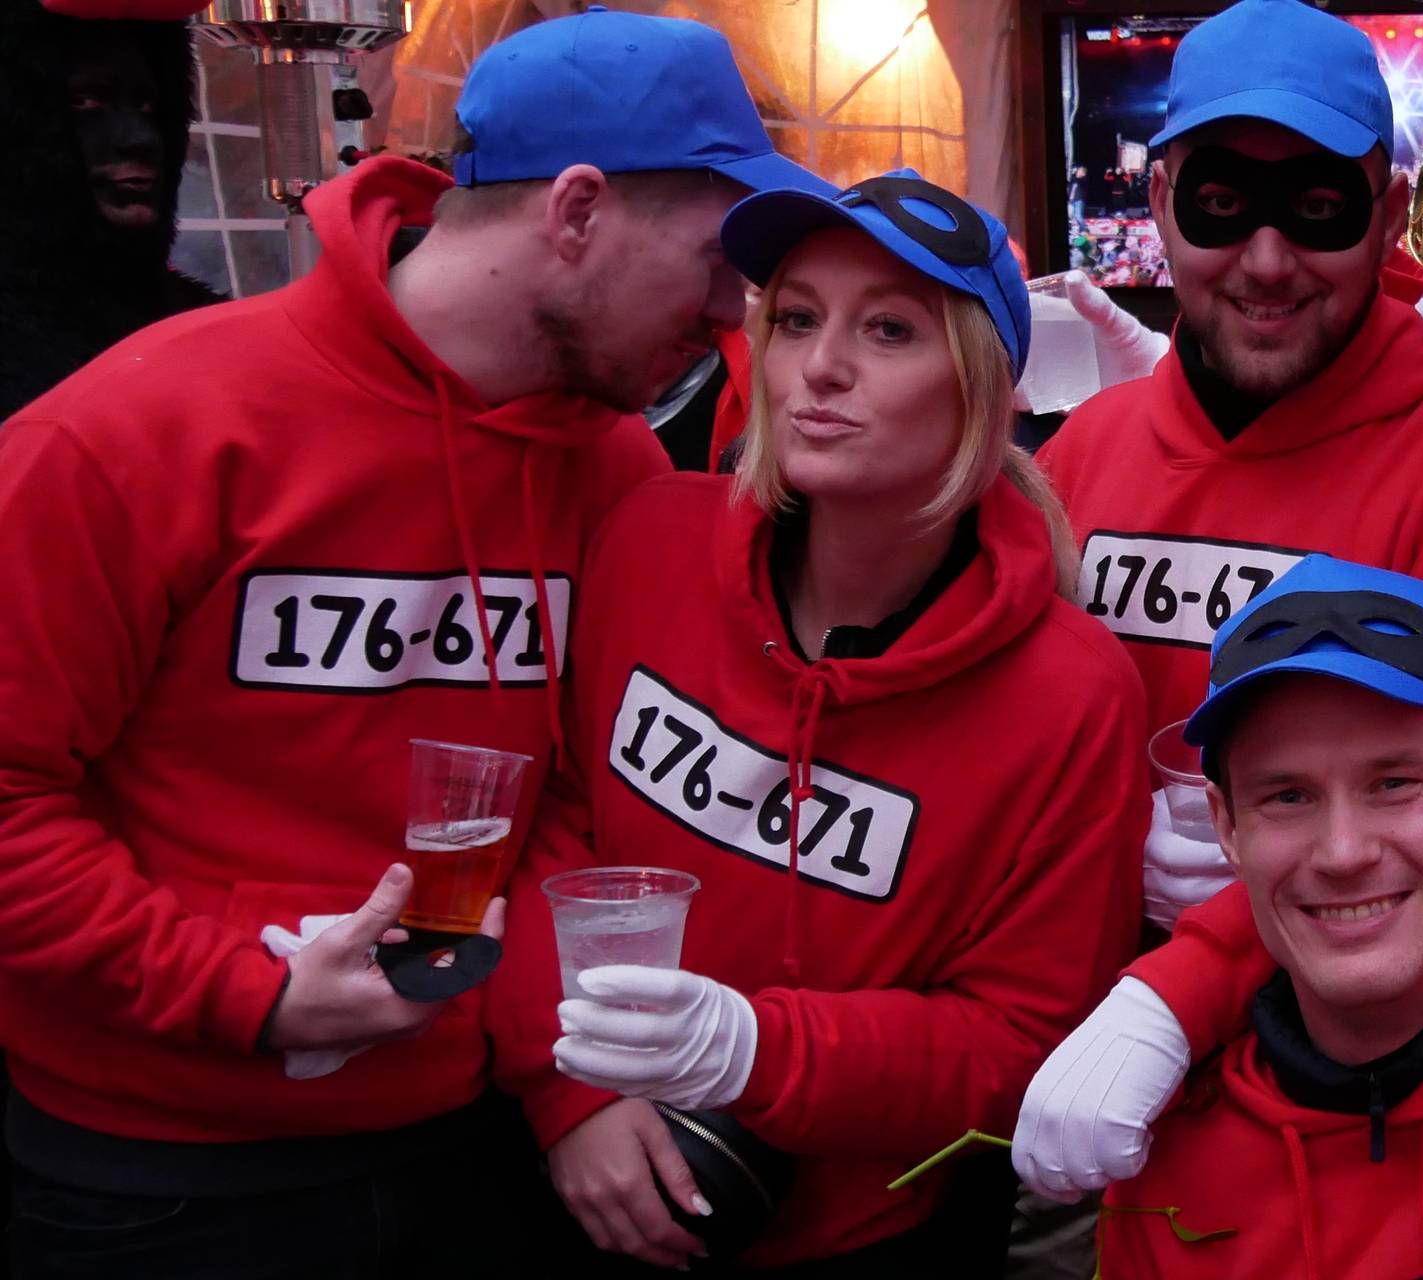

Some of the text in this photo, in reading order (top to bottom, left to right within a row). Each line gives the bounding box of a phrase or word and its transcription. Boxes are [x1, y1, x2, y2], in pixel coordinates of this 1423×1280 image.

[1086, 555, 1274, 630] 176-67
[265, 593, 550, 673] 176-671
[621, 706, 874, 877] 176-671
